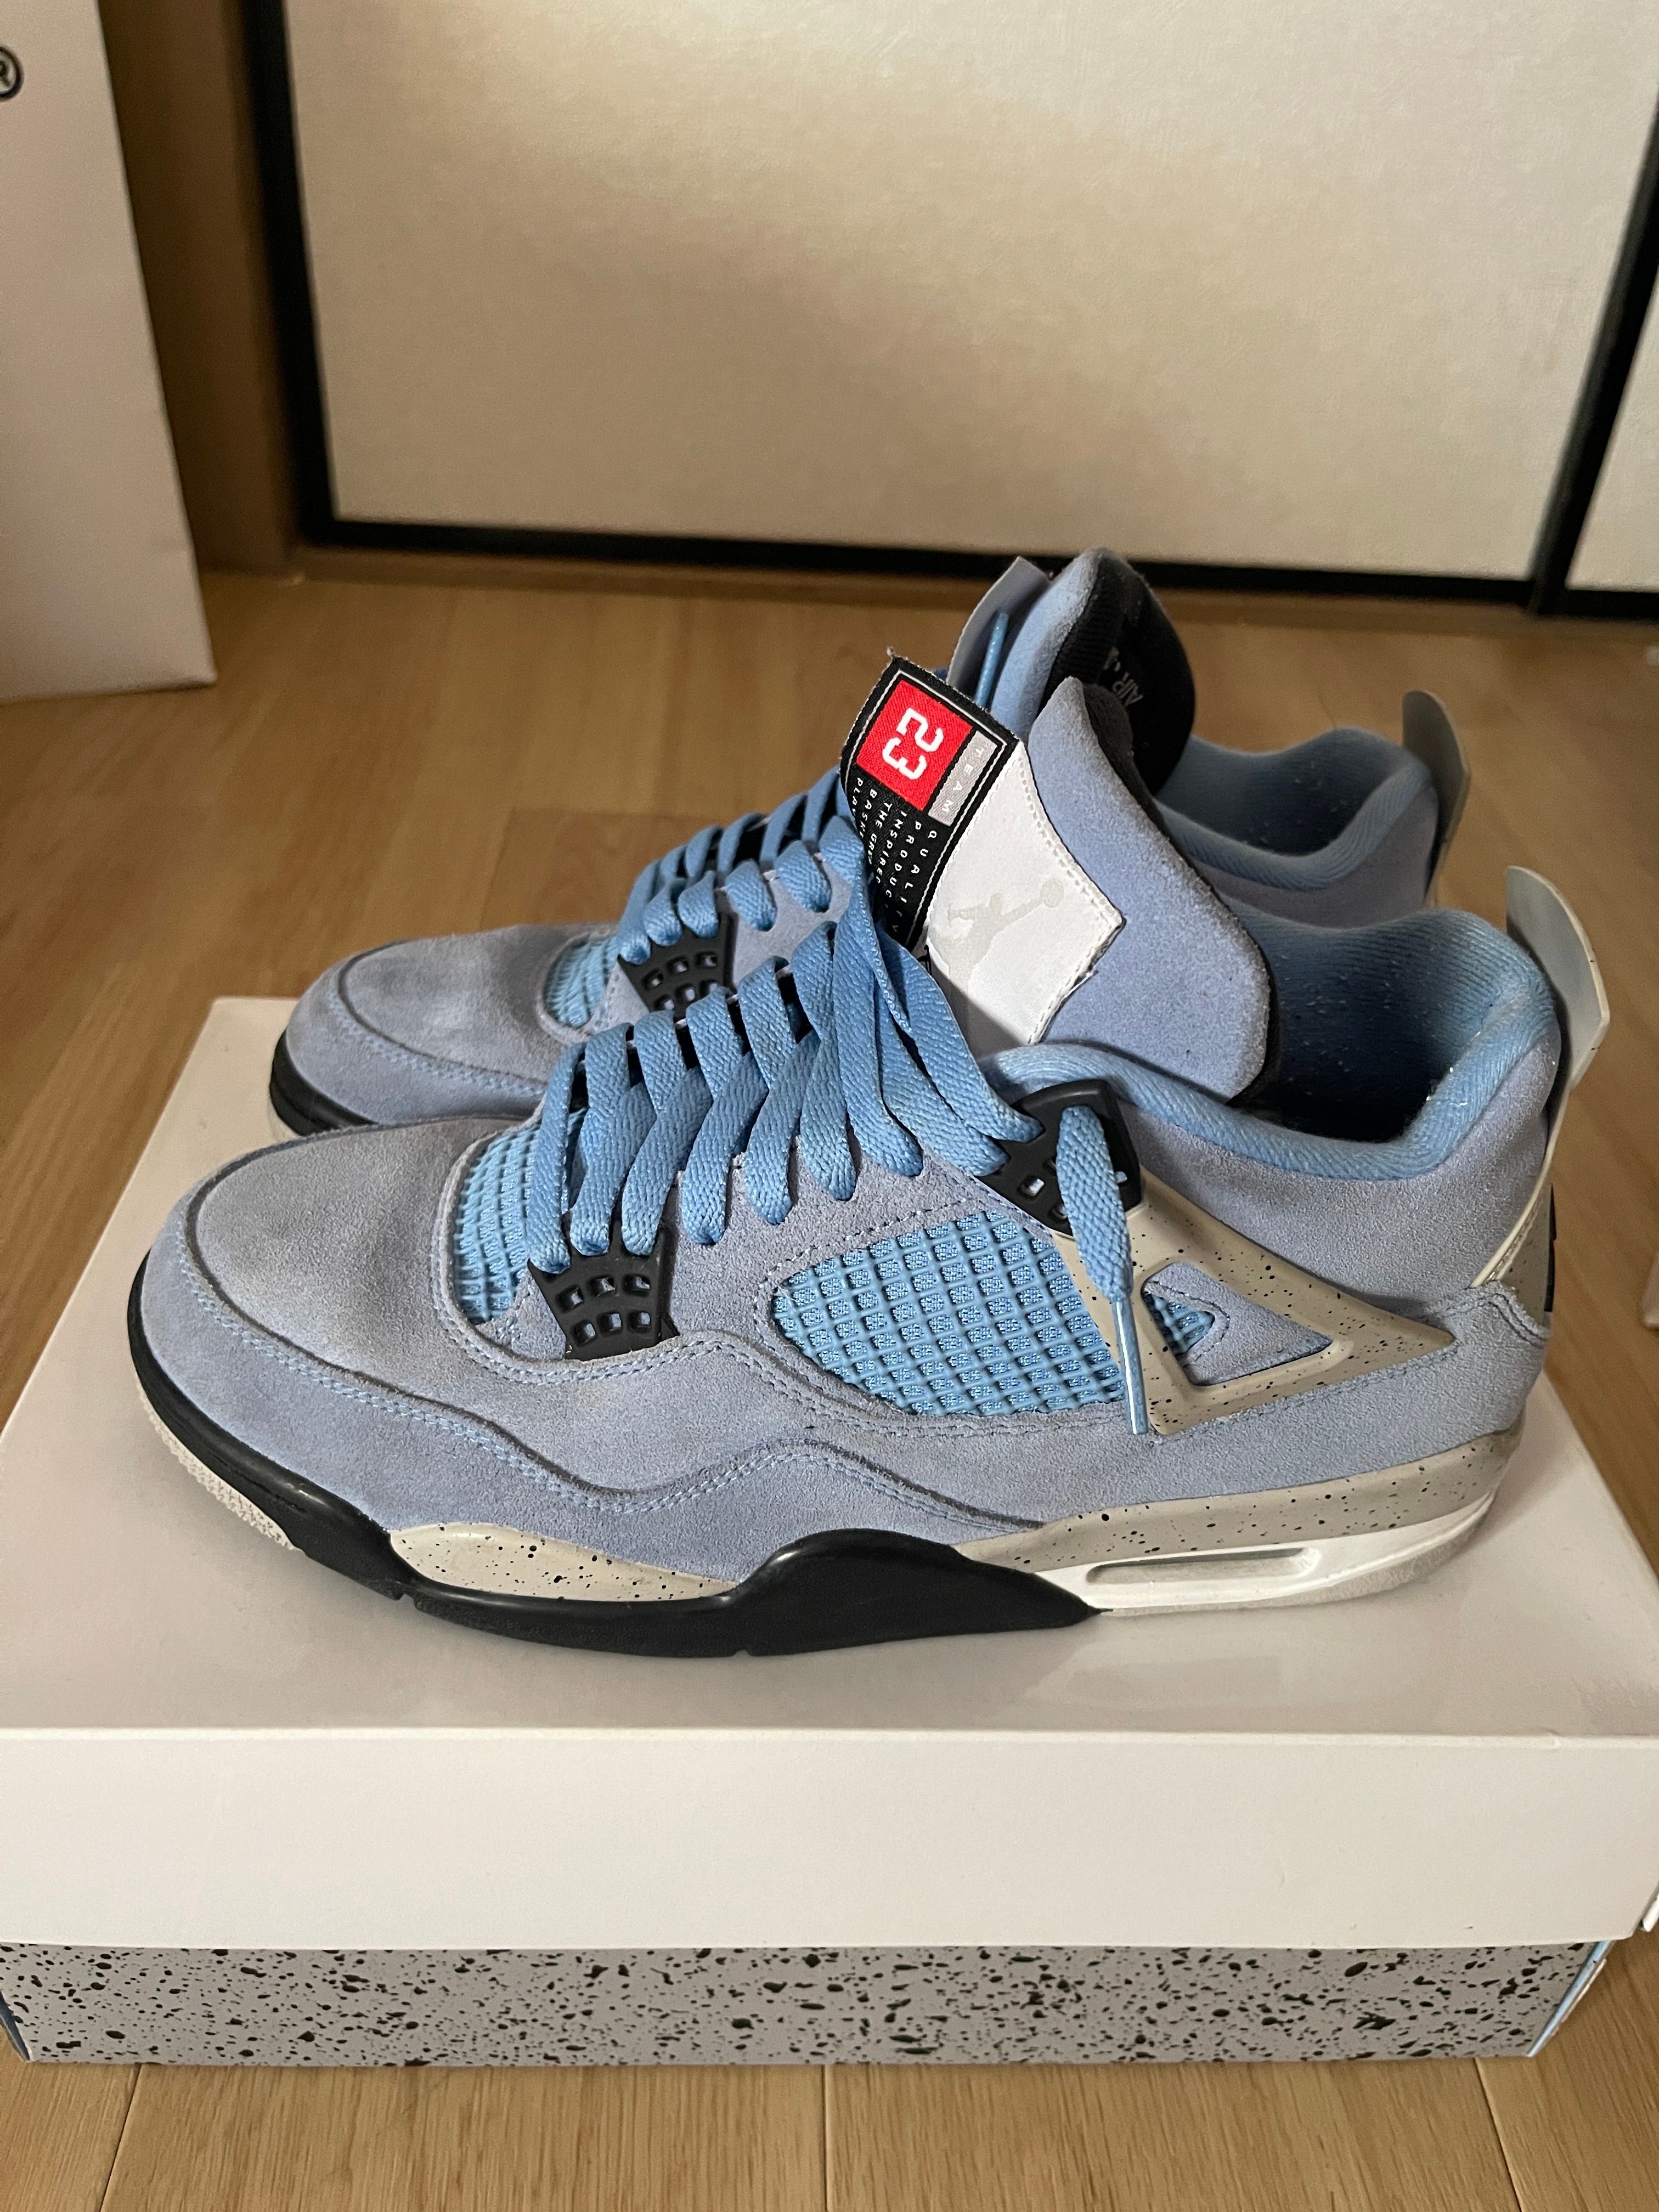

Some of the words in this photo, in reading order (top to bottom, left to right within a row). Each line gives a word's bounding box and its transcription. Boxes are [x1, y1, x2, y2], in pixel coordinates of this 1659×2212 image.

[1112, 672, 1143, 706] AIR
[882, 707, 944, 780] 23
[941, 746, 984, 814] TEAM
[875, 803, 893, 828] THE
[884, 821, 922, 909] PRODUC
